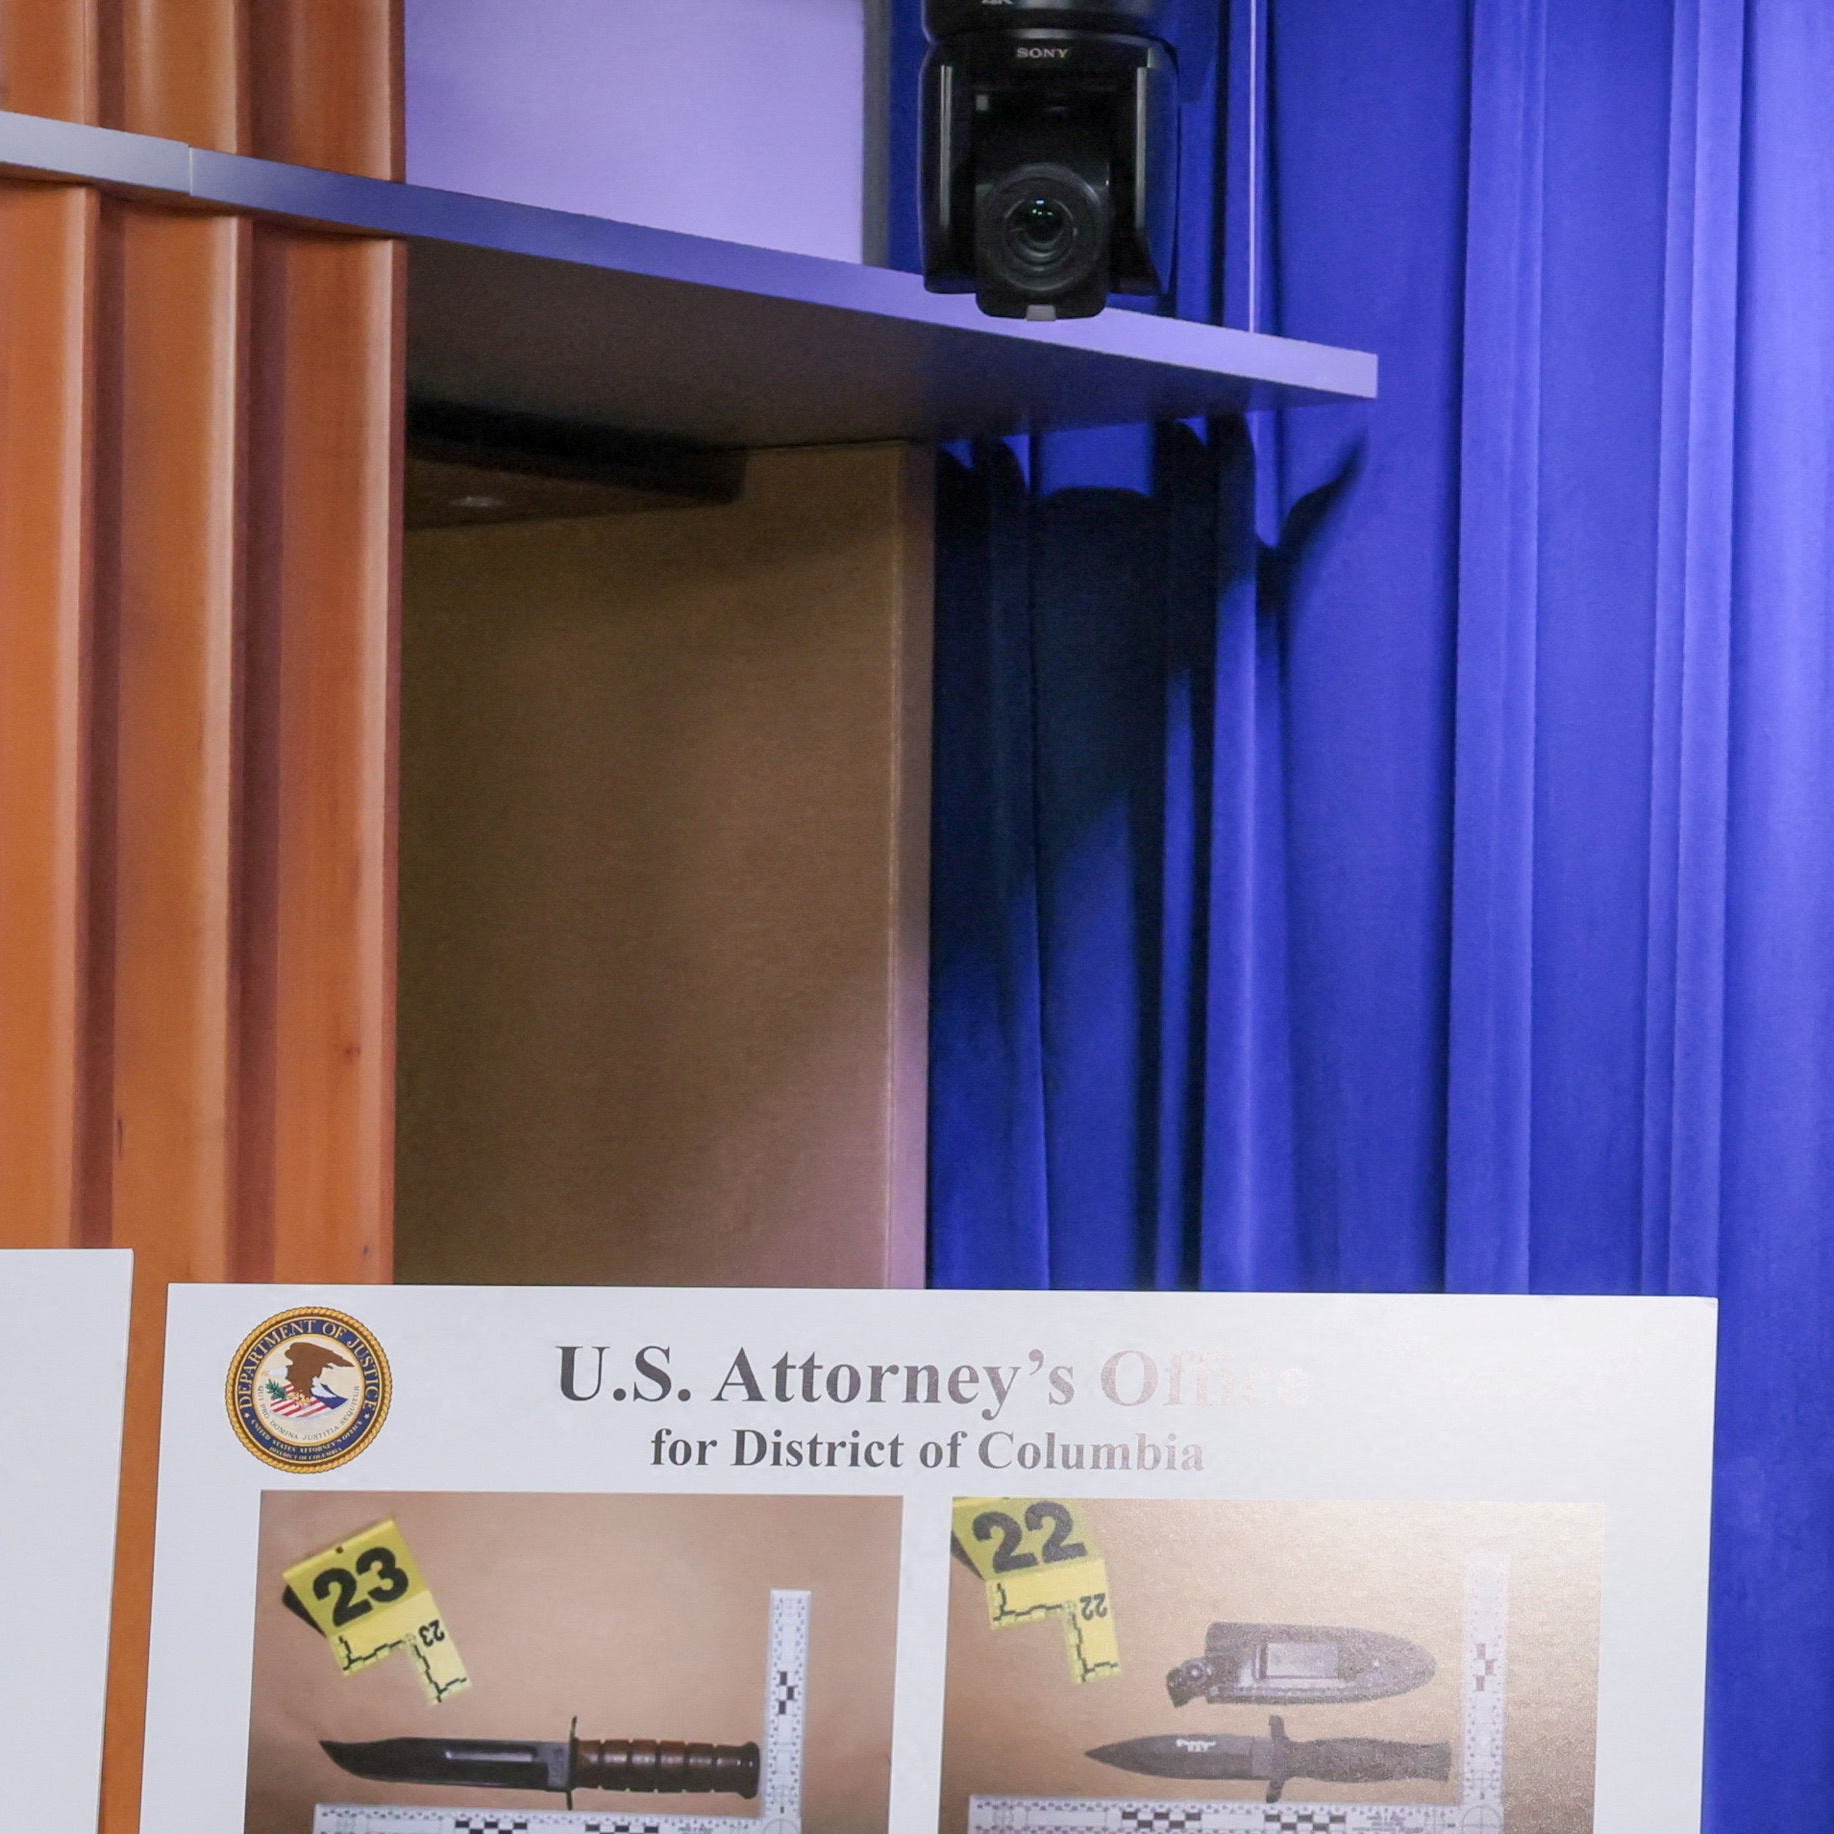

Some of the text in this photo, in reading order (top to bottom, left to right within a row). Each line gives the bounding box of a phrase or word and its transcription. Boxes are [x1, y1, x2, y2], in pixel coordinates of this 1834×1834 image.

[1017, 47, 1068, 59] SONY
[239, 1320, 378, 1415] DEPARTMENT OF JUSTICE
[556, 1345, 691, 1402] U.S.
[711, 1346, 1075, 1421] Attorney's
[270, 1420, 298, 1440] DOMINA
[302, 1425, 340, 1441] JUSTITIA
[650, 1428, 1205, 1472] for District of Columbia
[972, 1501, 1089, 1574] 22
[313, 1547, 409, 1627] 23
[1079, 1592, 1109, 1621] 22
[418, 1619, 445, 1648] 23
